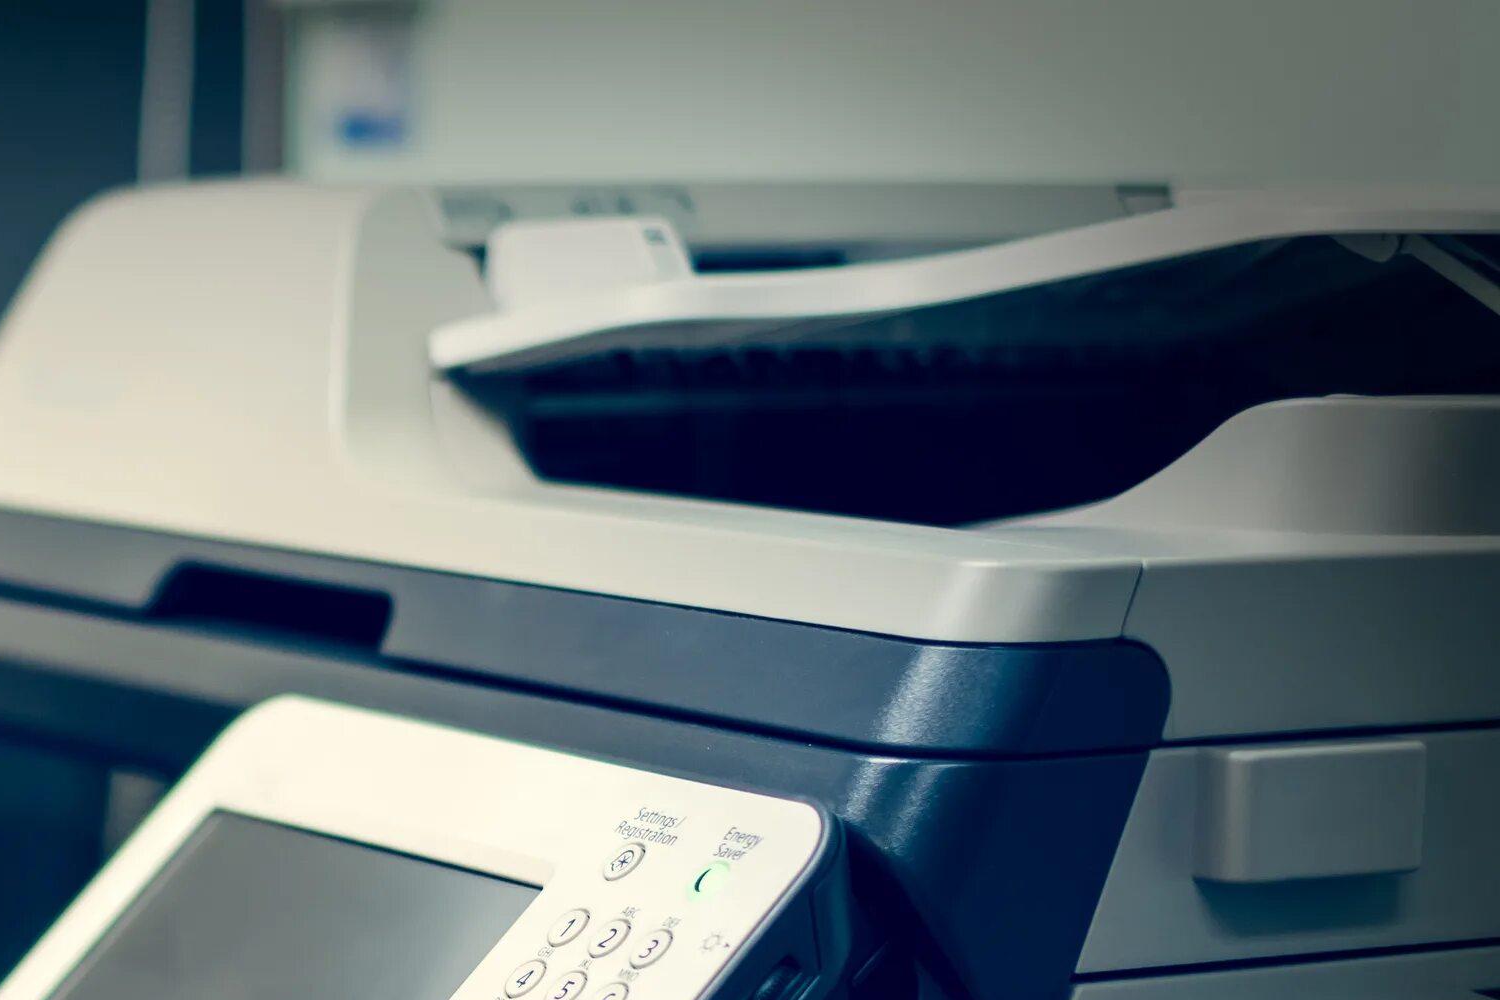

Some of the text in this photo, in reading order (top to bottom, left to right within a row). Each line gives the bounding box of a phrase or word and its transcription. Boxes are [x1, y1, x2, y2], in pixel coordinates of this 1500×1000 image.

[615, 821, 678, 846] Registration
[724, 827, 764, 849] Energy
[713, 843, 748, 861] Saver
[560, 918, 577, 937] 1
[597, 928, 617, 948] 2
[639, 939, 659, 958] 3
[516, 970, 534, 988] 4
[554, 981, 575, 999] 5
